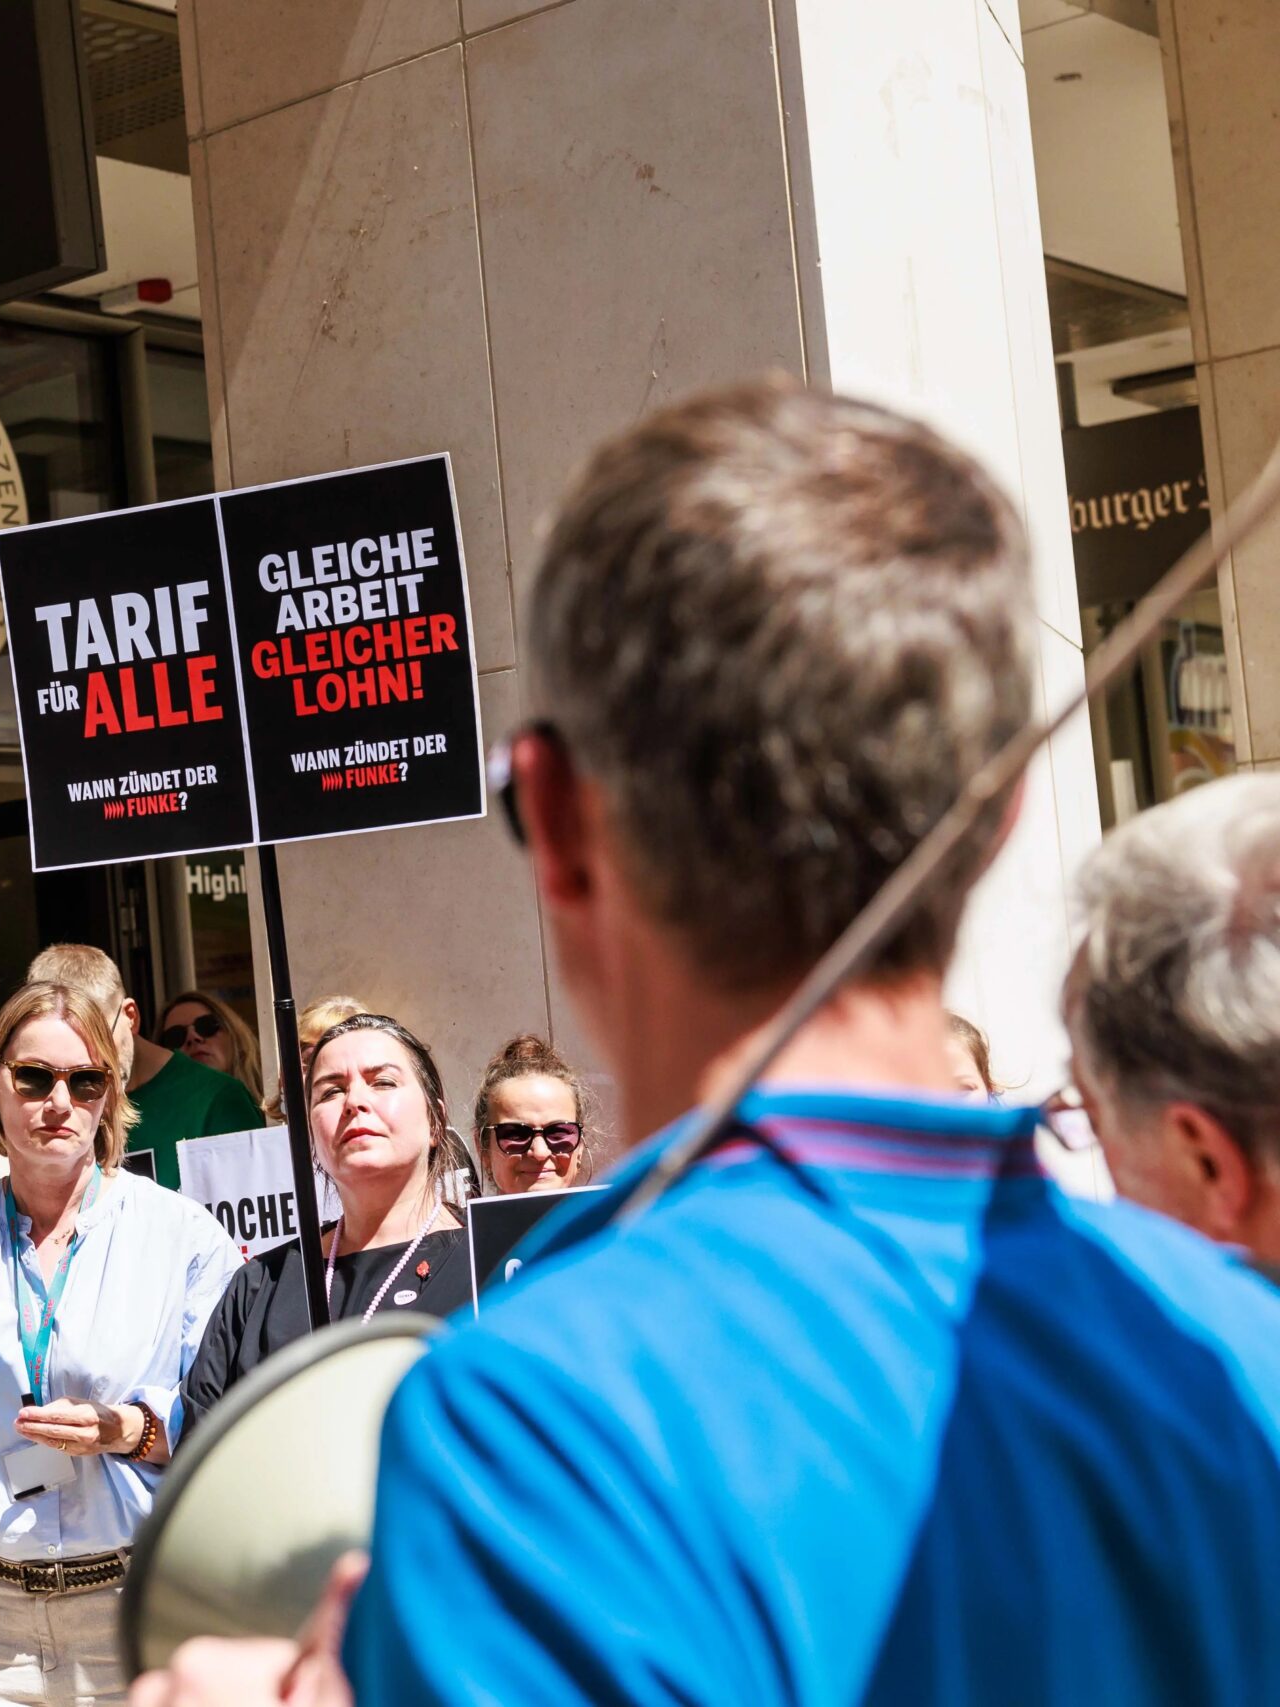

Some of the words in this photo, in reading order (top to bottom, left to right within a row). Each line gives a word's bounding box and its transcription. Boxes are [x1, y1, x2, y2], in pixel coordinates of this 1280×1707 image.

[258, 527, 439, 593] GLEICHE
[34, 580, 210, 673] TARIF
[275, 573, 424, 634] ARBEIT
[251, 613, 459, 680] GLEICHER
[36, 680, 81, 715] FÜR
[84, 655, 224, 738] ALLE
[292, 661, 424, 717] LOHN!
[291, 748, 340, 773] WANN
[344, 737, 409, 766] ZÜNDET
[413, 733, 447, 756] DER
[345, 762, 408, 789] FUNKE?
[67, 778, 116, 802] WANN
[119, 769, 181, 796] ZÜNDET
[185, 765, 218, 787] DER
[127, 791, 188, 818] FUNKE?
[204, 1192, 297, 1242] OCHE
